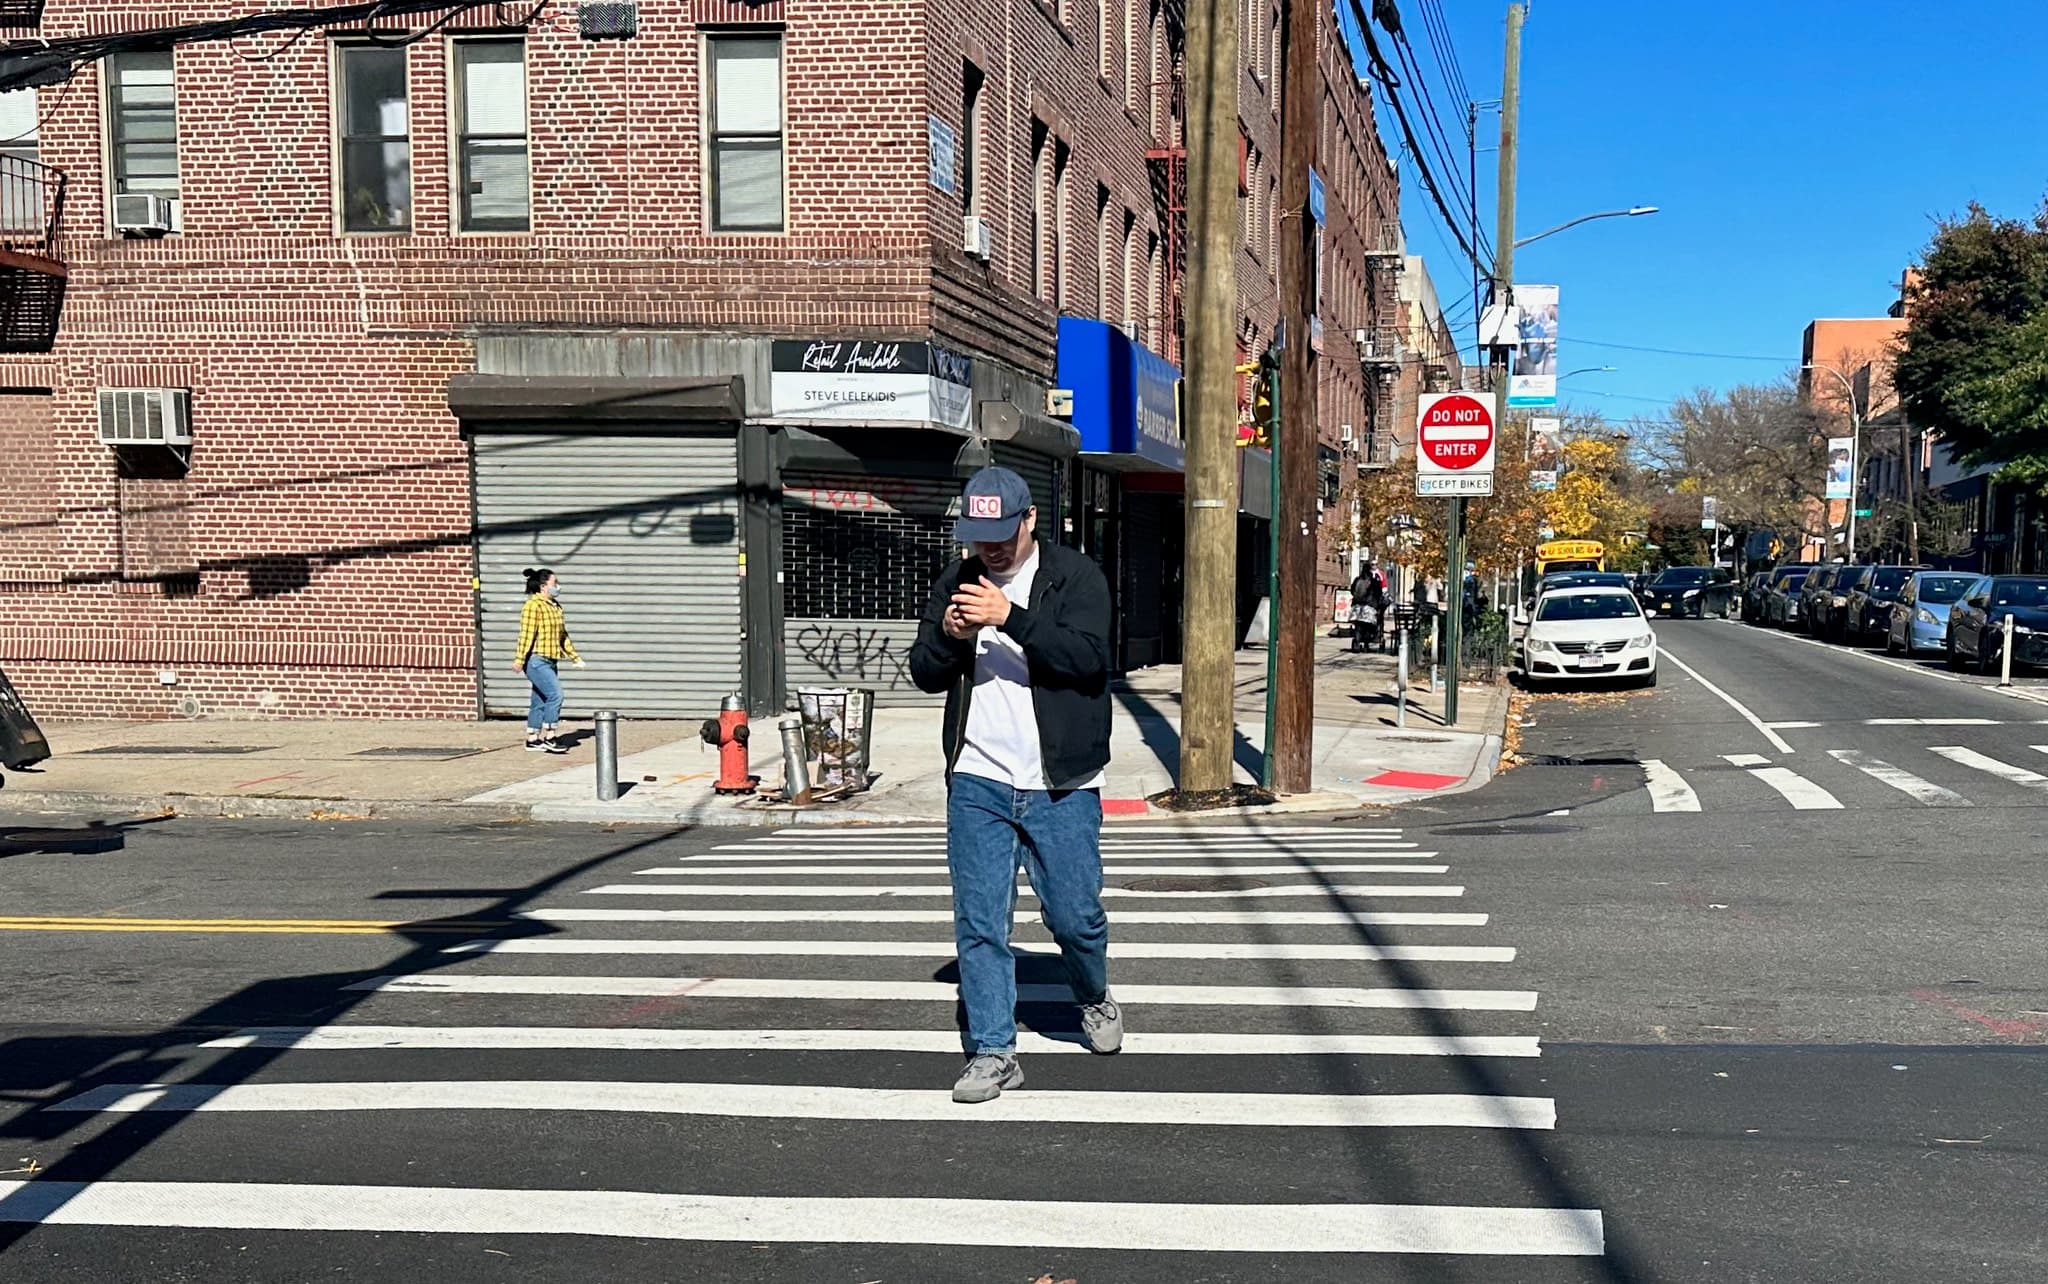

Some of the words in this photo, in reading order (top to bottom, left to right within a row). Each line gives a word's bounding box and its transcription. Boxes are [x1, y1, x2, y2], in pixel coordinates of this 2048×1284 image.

[804, 390, 839, 401] STEVE
[842, 391, 896, 402] LELEKIDIS
[1432, 410, 1450, 422] DO
[1455, 409, 1480, 422] NOT
[1435, 443, 1477, 456] ENTER
[1460, 480, 1489, 489] BIKES
[971, 497, 999, 514] ICO
